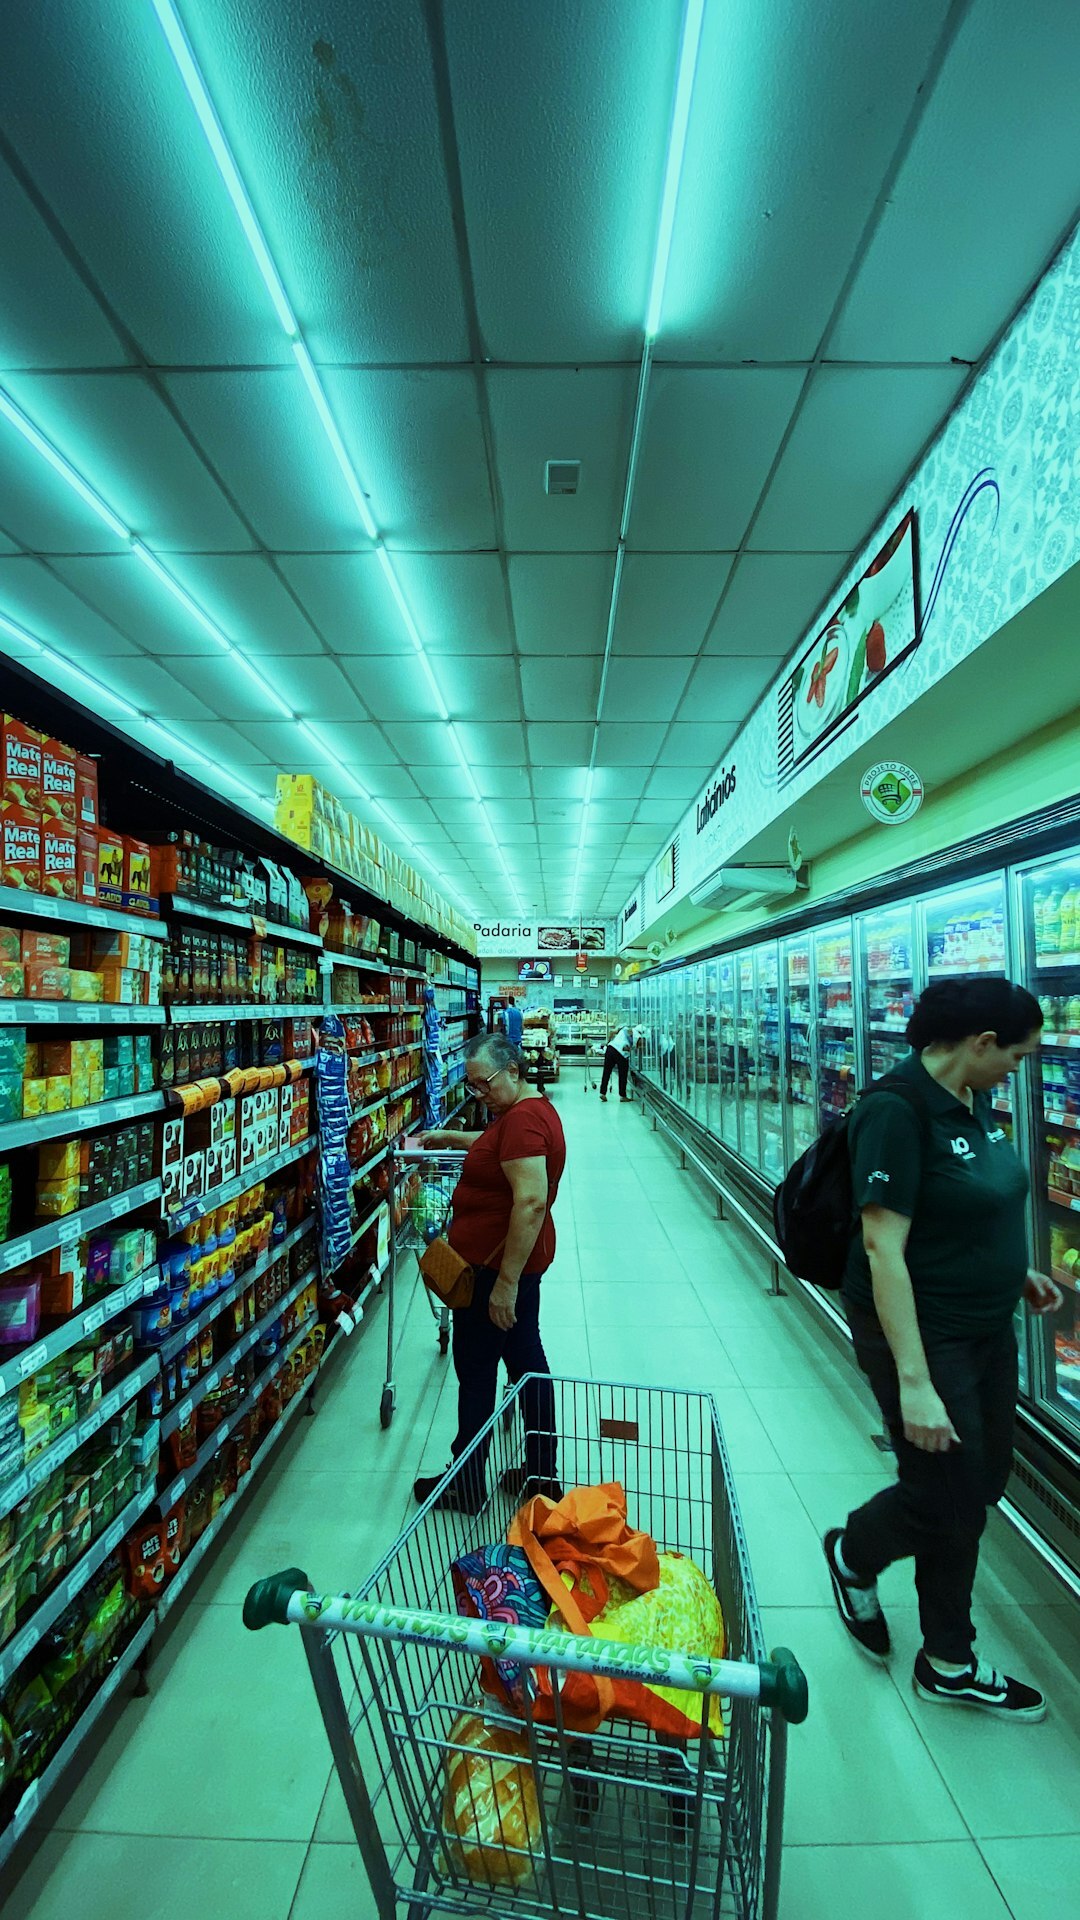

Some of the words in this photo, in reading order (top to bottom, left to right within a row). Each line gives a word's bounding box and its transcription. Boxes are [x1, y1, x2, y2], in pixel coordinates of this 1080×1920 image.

[6, 742, 41, 763] Mate
[6, 757, 41, 778] Real
[43, 759, 76, 779] Mate
[864, 763, 897, 786] PROJETO
[43, 774, 75, 793] Real
[4, 827, 40, 844] Mate
[4, 843, 40, 860] Real
[44, 839, 76, 855] Mate
[45, 854, 76, 870] Real
[473, 923, 531, 937] Padaria
[529, 1627, 671, 1674] Varandas
[592, 1664, 672, 1684] SUPERMERCADOS
